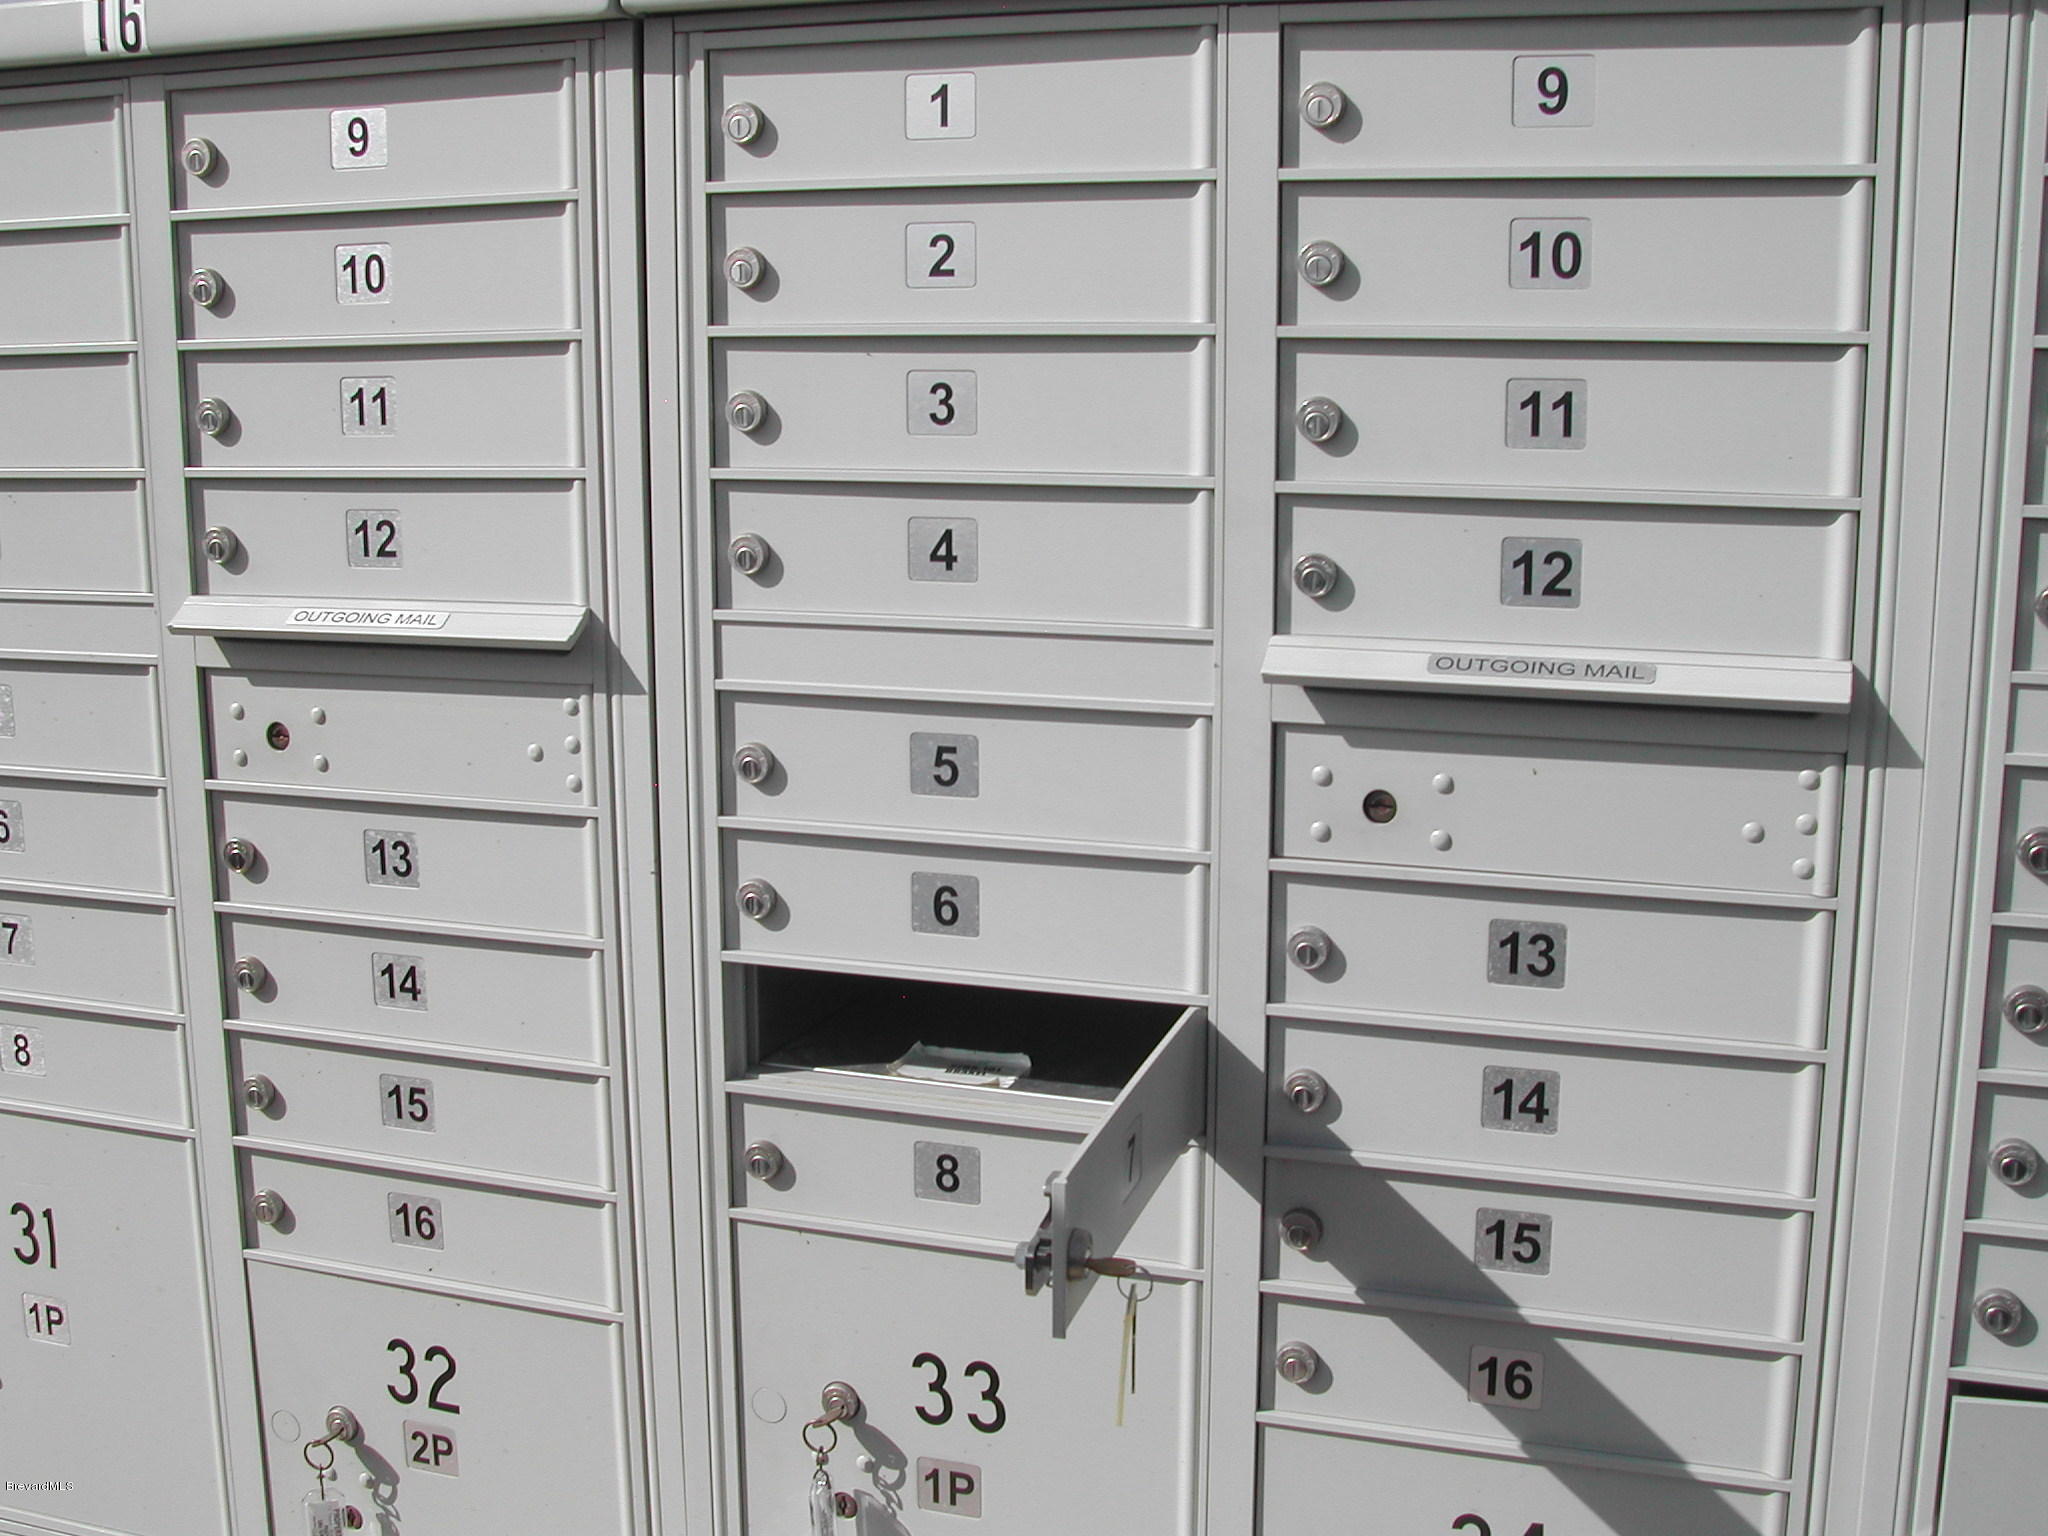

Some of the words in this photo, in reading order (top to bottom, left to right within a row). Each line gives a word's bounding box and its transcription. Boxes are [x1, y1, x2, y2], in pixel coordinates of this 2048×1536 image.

[98, 0, 142, 53] 16
[930, 83, 949, 128] 1
[1538, 67, 1568, 115] 9
[348, 117, 369, 157] 9
[343, 253, 385, 294] 10
[929, 233, 955, 278] 2
[1519, 231, 1582, 280] 10
[351, 386, 387, 426] 11
[930, 382, 955, 426] 3
[1520, 390, 1573, 438] 11
[355, 519, 397, 558] 12
[929, 528, 958, 572] 4
[1513, 549, 1572, 597] 12
[293, 610, 392, 624] OUTGOING
[394, 613, 438, 626] MAIL
[1435, 656, 1576, 676] OUTGOING
[1583, 663, 1645, 680] MAIL
[933, 745, 959, 788] 5
[371, 838, 413, 878] 13
[934, 885, 960, 927] 6
[1, 921, 19, 955] 7
[1499, 930, 1556, 978] 13
[380, 962, 422, 1002] 14
[13, 1033, 31, 1067] 8
[387, 1084, 429, 1123] 15
[1493, 1078, 1550, 1124] 14
[935, 1153, 960, 1193] 8
[10, 1202, 57, 1270] 31
[395, 1202, 436, 1241] 16
[1485, 1219, 1541, 1264] 15
[28, 1302, 64, 1338] 1P
[387, 1338, 461, 1415] 32
[911, 1352, 1007, 1434] 33
[1477, 1356, 1533, 1401] 16
[411, 1430, 454, 1467] 2P
[924, 1467, 975, 1507] 1P
